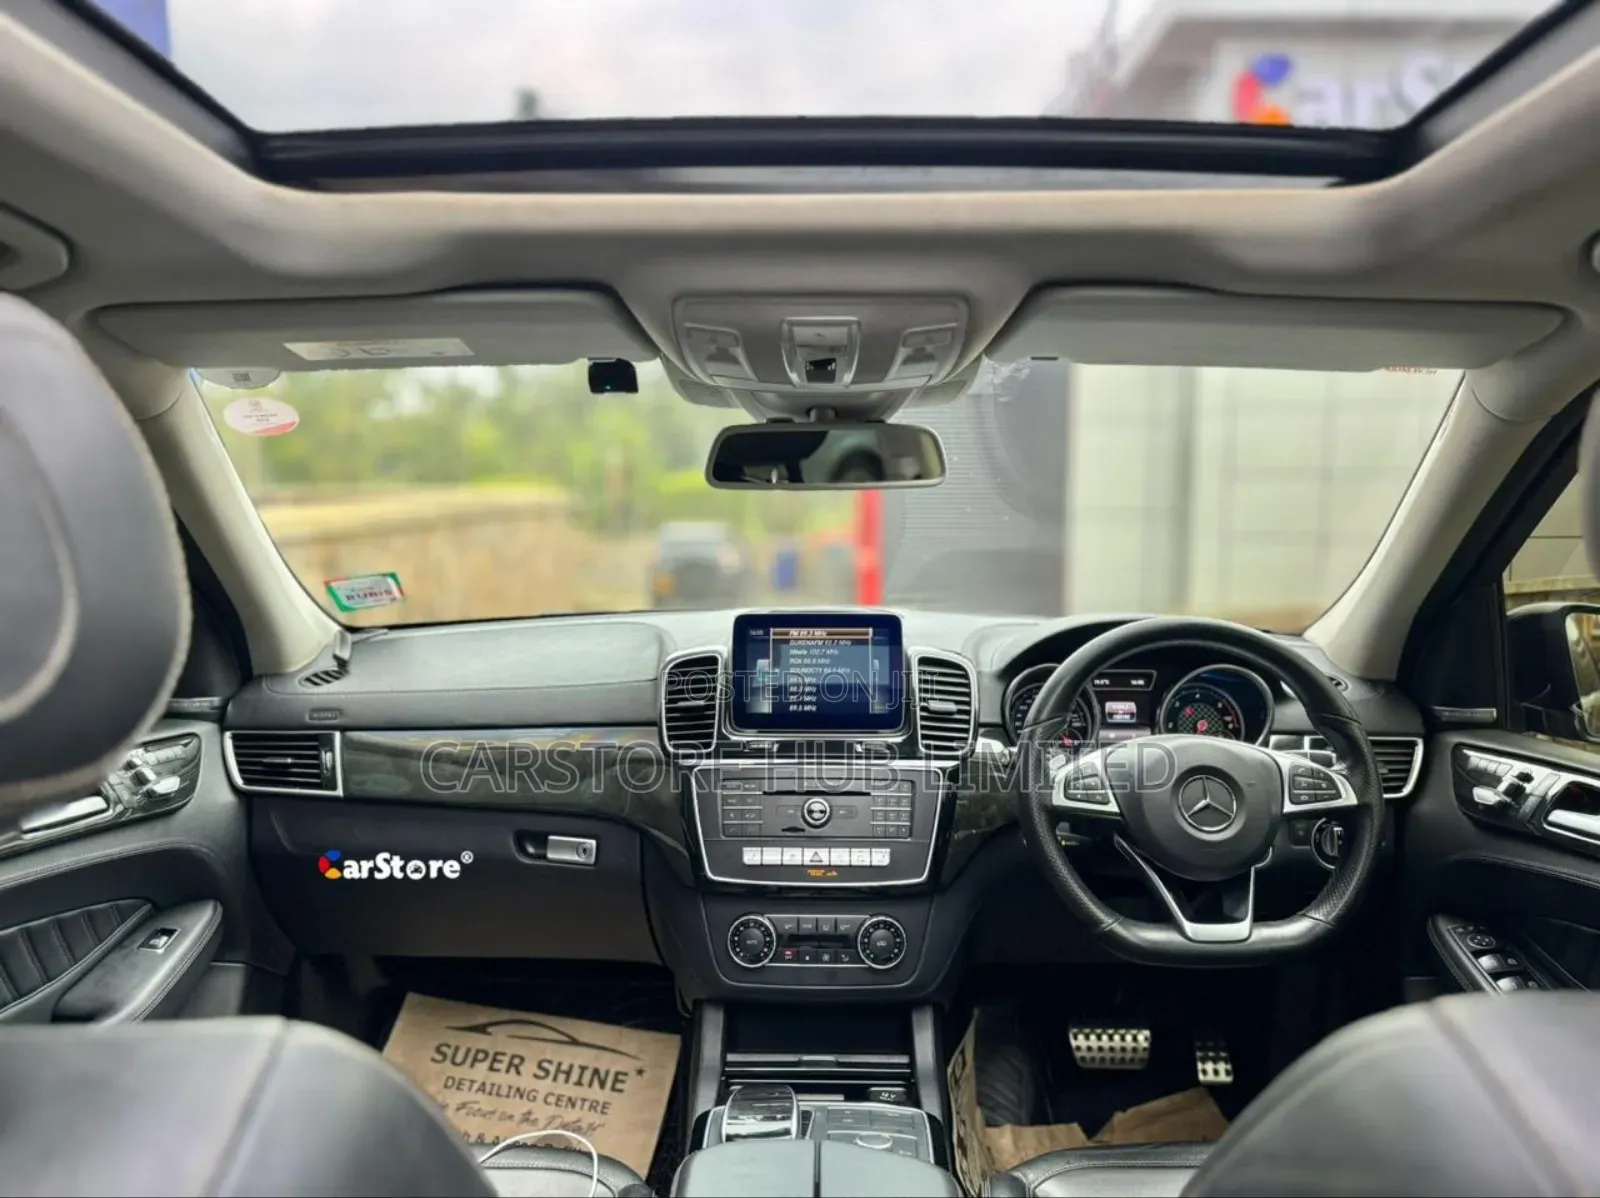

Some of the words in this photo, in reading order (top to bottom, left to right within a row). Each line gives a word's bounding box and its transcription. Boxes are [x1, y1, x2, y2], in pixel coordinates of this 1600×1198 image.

[430, 1043, 525, 1076] SUPER
[533, 1058, 628, 1093] SHINE
[443, 1075, 539, 1102] DETAILING
[544, 1092, 612, 1115] CENTRE
